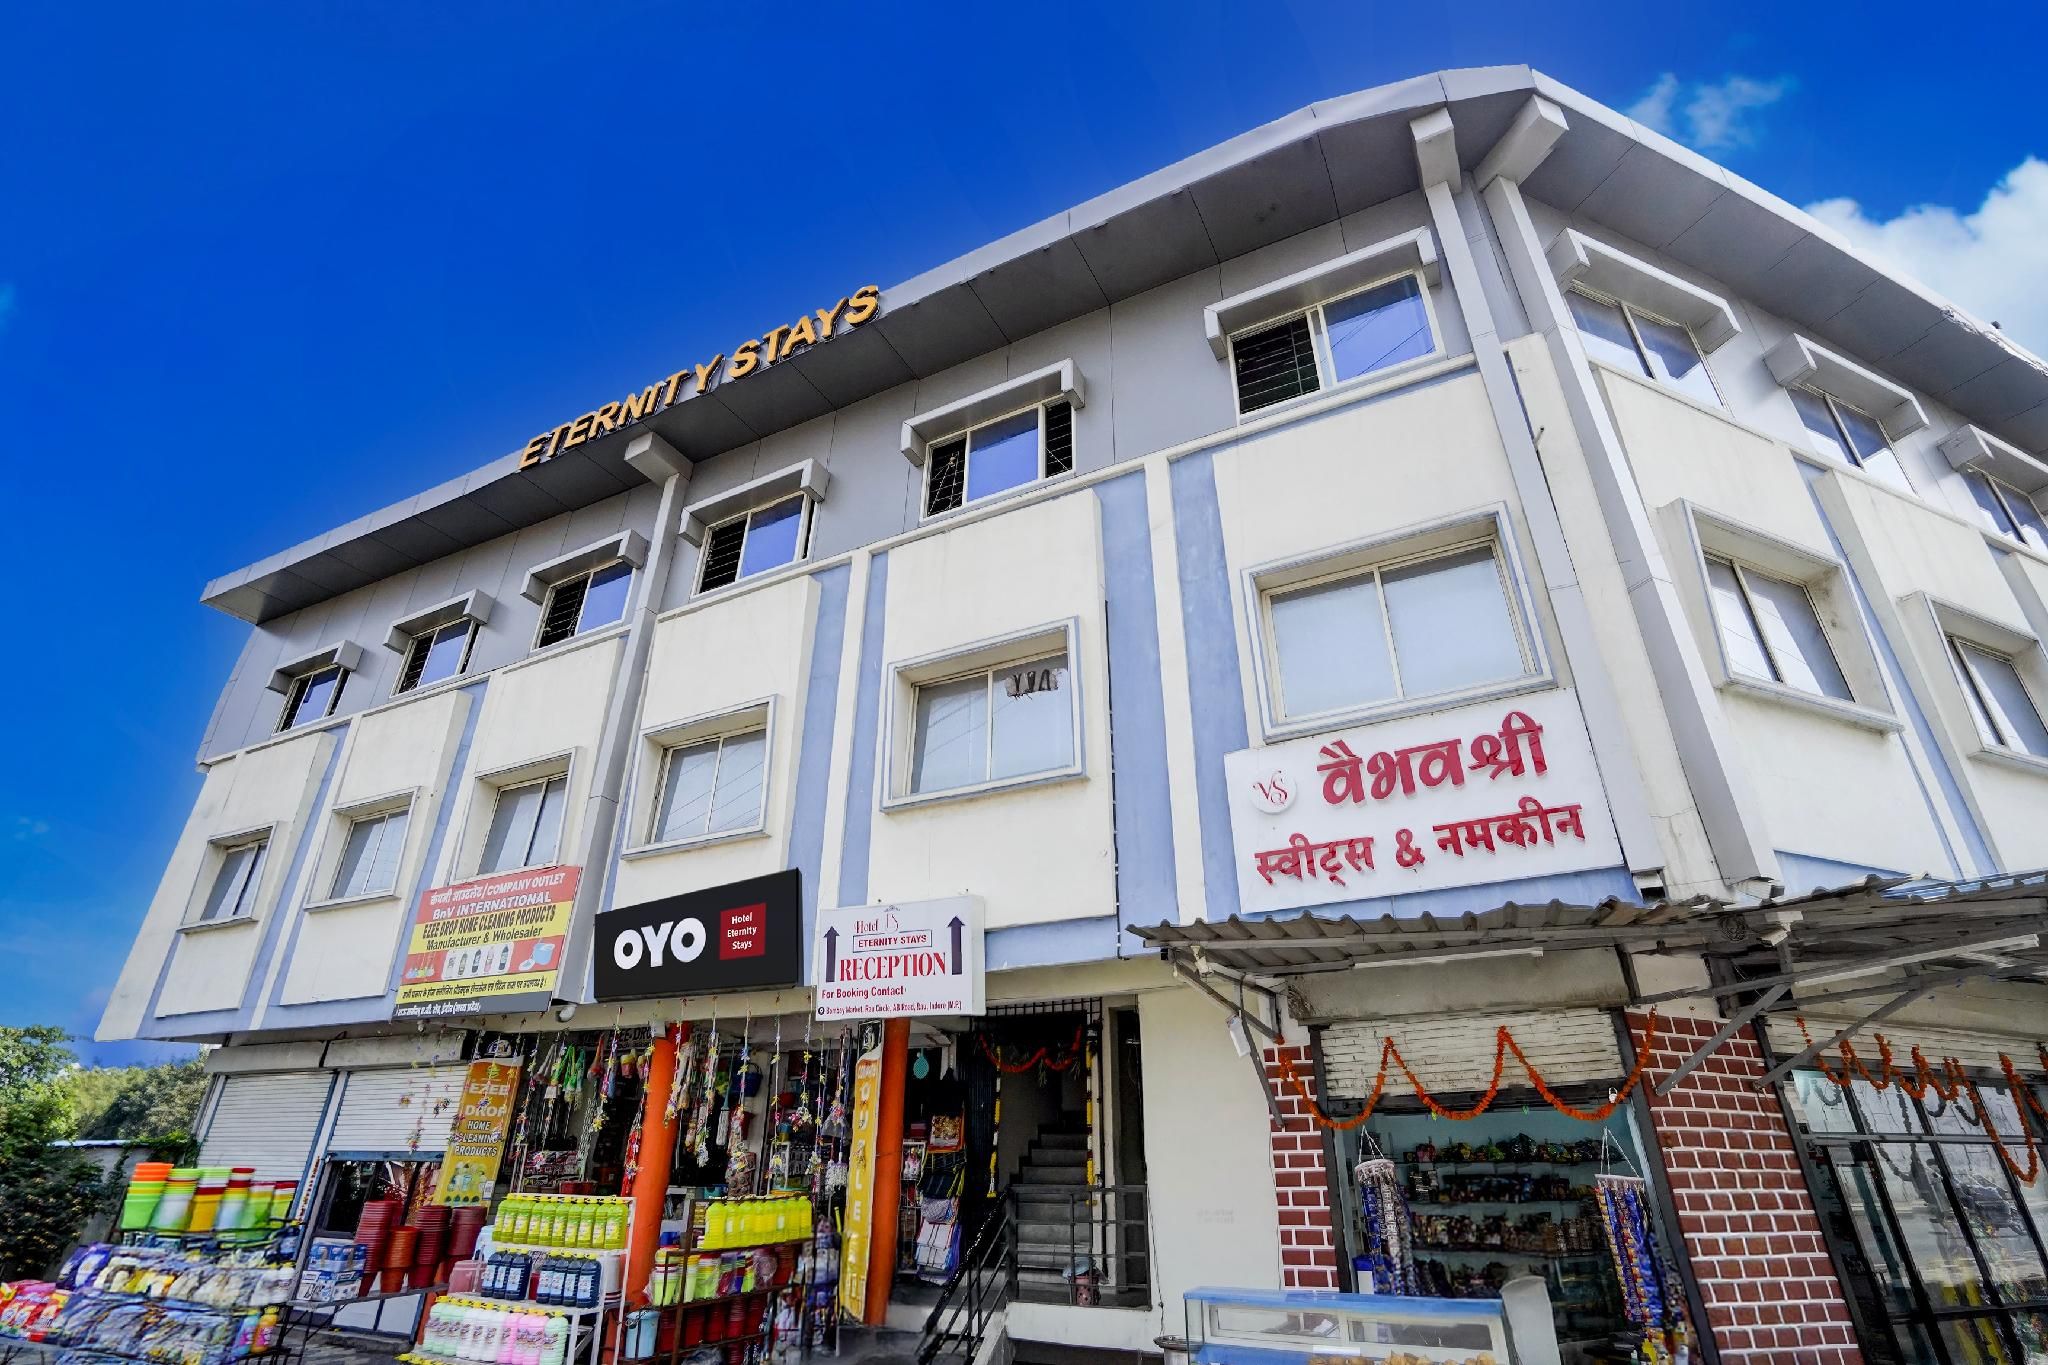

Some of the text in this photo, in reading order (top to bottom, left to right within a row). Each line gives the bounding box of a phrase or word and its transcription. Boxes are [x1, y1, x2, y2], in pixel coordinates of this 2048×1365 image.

[519, 285, 880, 470] ETERNITY STAYS
[1254, 796, 1586, 886] स्वीट्स & नमकीन
[531, 873, 566, 887] OUTLET
[433, 891, 551, 920] BnV INTERNATIONAL
[440, 918, 459, 937] DROP
[458, 915, 480, 934] HOME
[478, 910, 515, 932] CLEANING
[515, 904, 557, 926] PRODUCTS
[731, 912, 752, 925] Hotel
[854, 918, 879, 933] Hotel
[426, 926, 543, 951] Manufacturer & Wholesaler
[727, 926, 757, 939] Eternity
[614, 917, 706, 969] OYO
[732, 940, 752, 950] Stays
[858, 934, 927, 948] ETERNITY STAYS
[840, 952, 946, 981] RECEPTION
[821, 989, 834, 999] For
[836, 987, 869, 999] Booking
[467, 1120, 491, 1130] HOME
